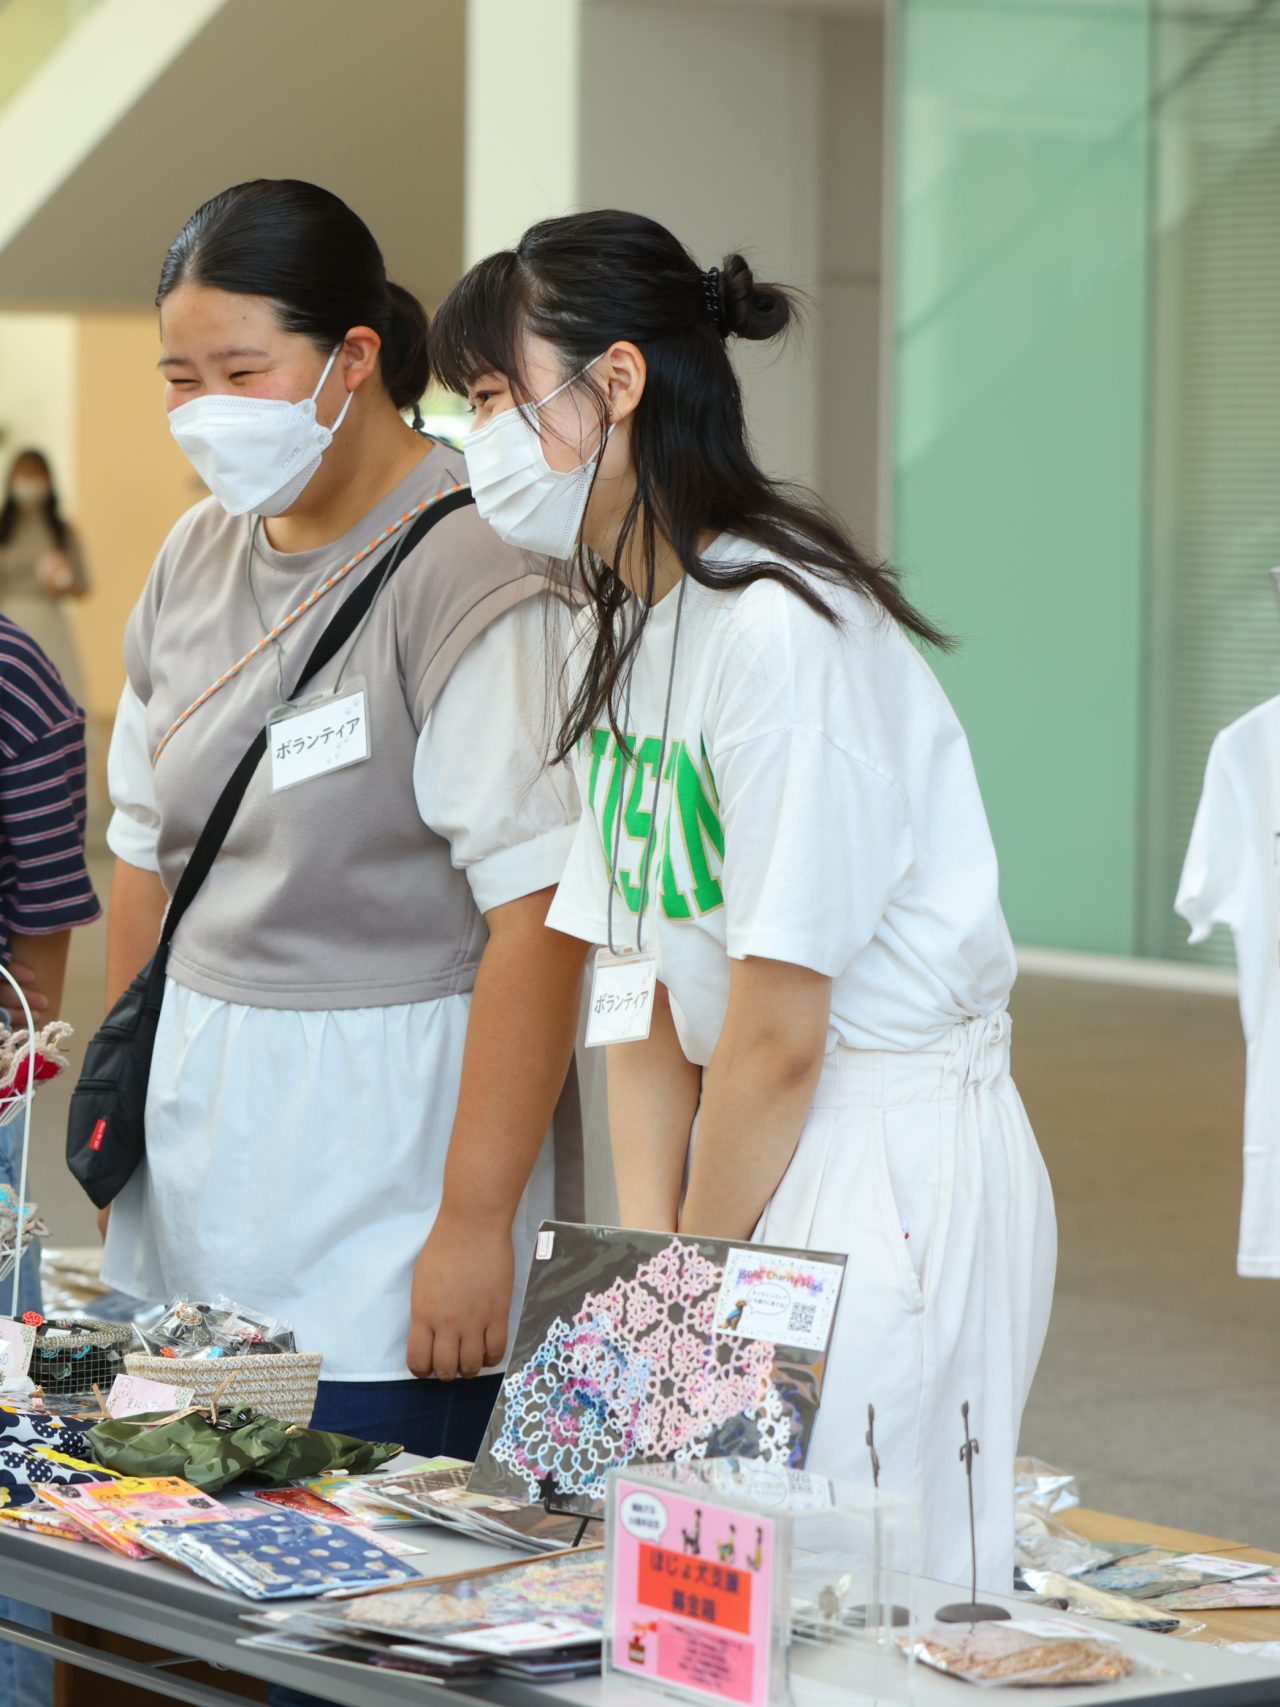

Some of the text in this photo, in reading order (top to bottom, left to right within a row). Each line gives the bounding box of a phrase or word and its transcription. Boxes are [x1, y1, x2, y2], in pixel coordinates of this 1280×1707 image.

[276, 717, 360, 760] ボランティア
[594, 990, 650, 1014] ボランティア
